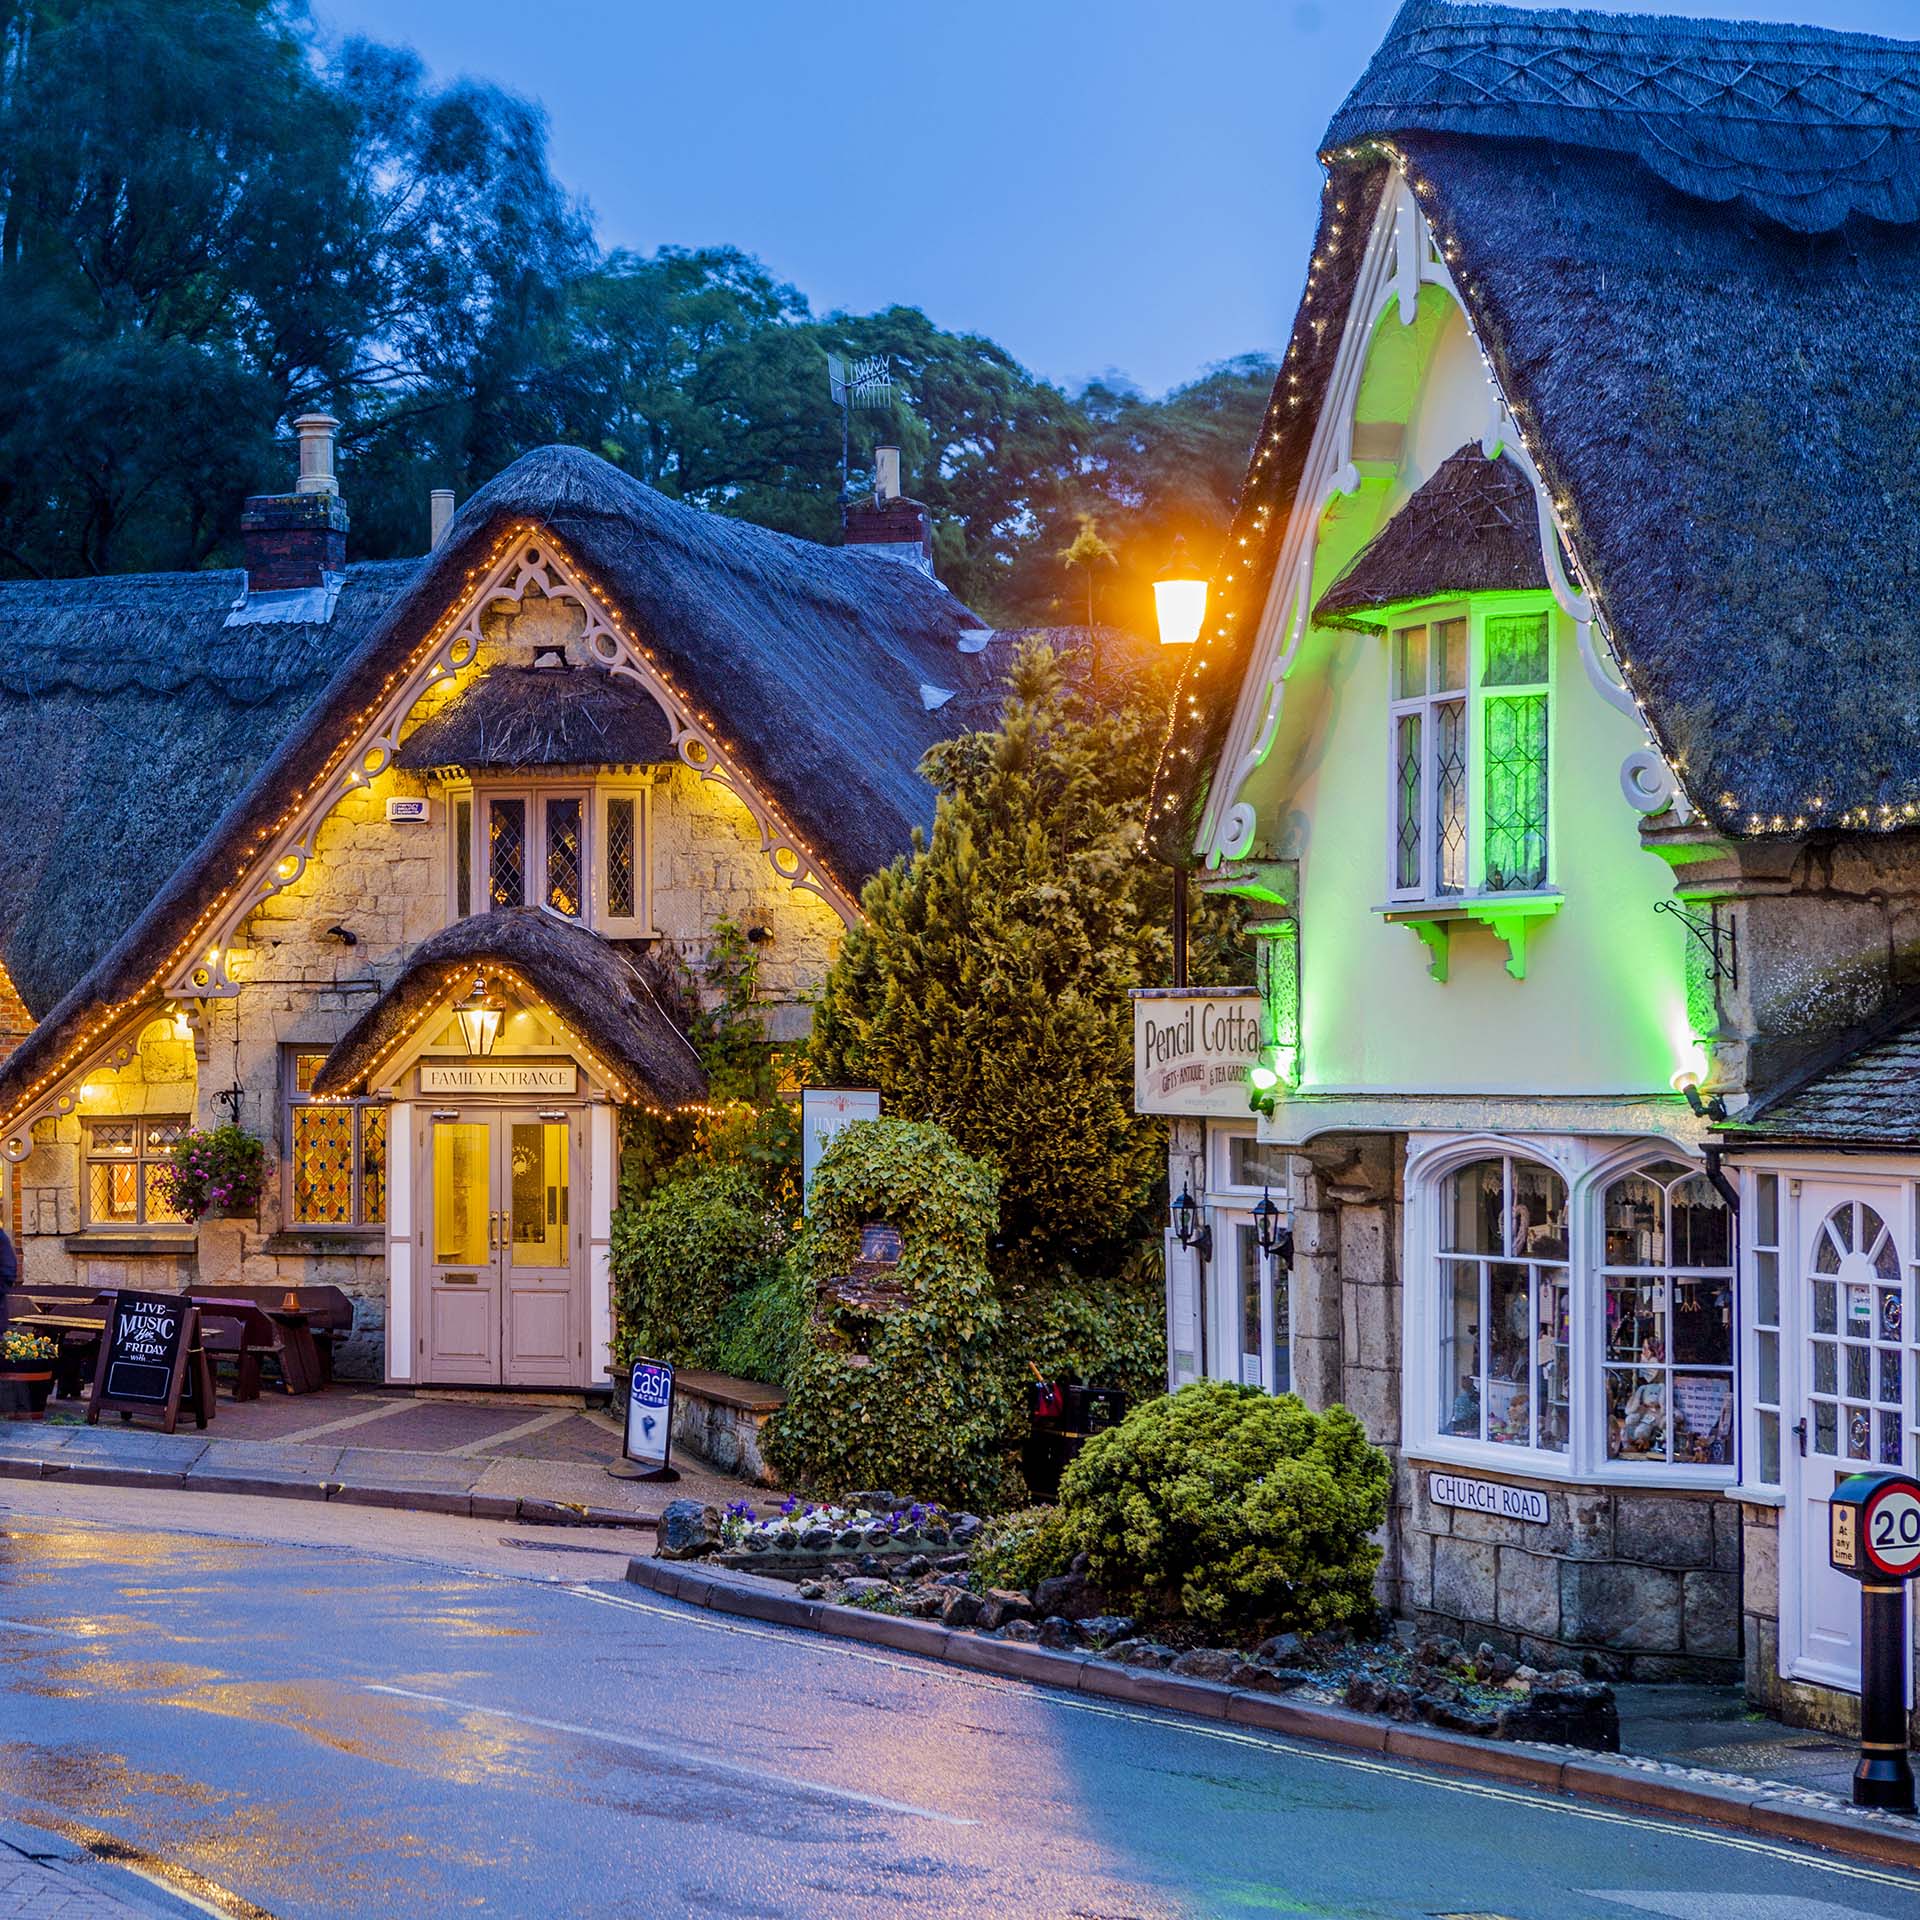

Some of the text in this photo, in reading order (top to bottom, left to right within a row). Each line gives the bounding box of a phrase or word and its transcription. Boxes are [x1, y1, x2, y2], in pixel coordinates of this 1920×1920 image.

[1145, 1002, 1264, 1069] Pencil Cotta
[431, 1071, 567, 1086] FAMILY ENTRANCE
[1215, 1066, 1226, 1083] TEA
[135, 1302, 166, 1315] LIVE
[116, 1313, 175, 1346] MUSIC
[124, 1342, 167, 1356] FRIDAY
[632, 1371, 671, 1399] cash
[1436, 1478, 1541, 1518] CHURCH ROAD
[1838, 1525, 1848, 1536] At
[1875, 1508, 1920, 1545] 20
[1836, 1538, 1850, 1548] any
[1835, 1549, 1853, 1561] time
